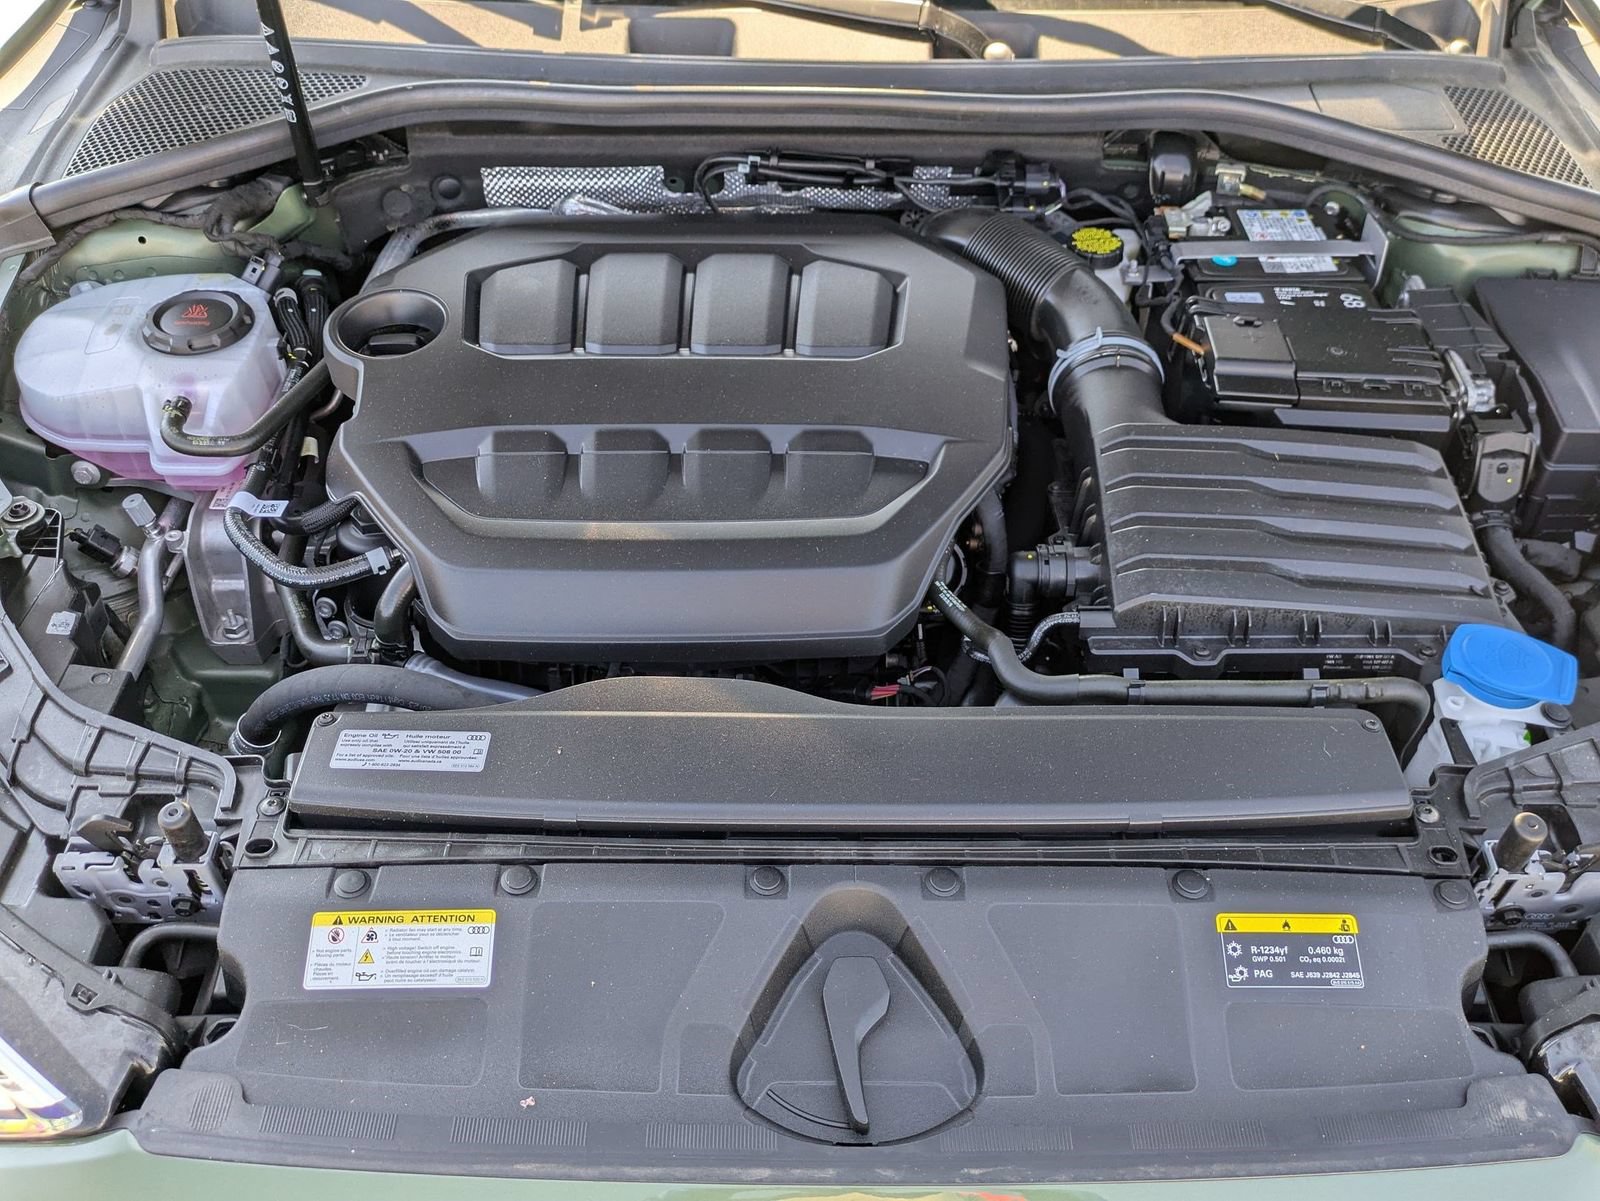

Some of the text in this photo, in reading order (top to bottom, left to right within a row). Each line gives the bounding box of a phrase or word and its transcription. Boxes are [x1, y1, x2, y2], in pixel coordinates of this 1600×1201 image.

[343, 732, 367, 740] Engine
[348, 913, 475, 925] WARNING ATTENTION
[1250, 945, 1344, 957] R-1234yf 0.460 kg
[1252, 955, 1269, 963] GWP
[1269, 955, 1286, 963] 0.501
[1254, 969, 1273, 979] PAG
[1291, 971, 1304, 979] SAE
